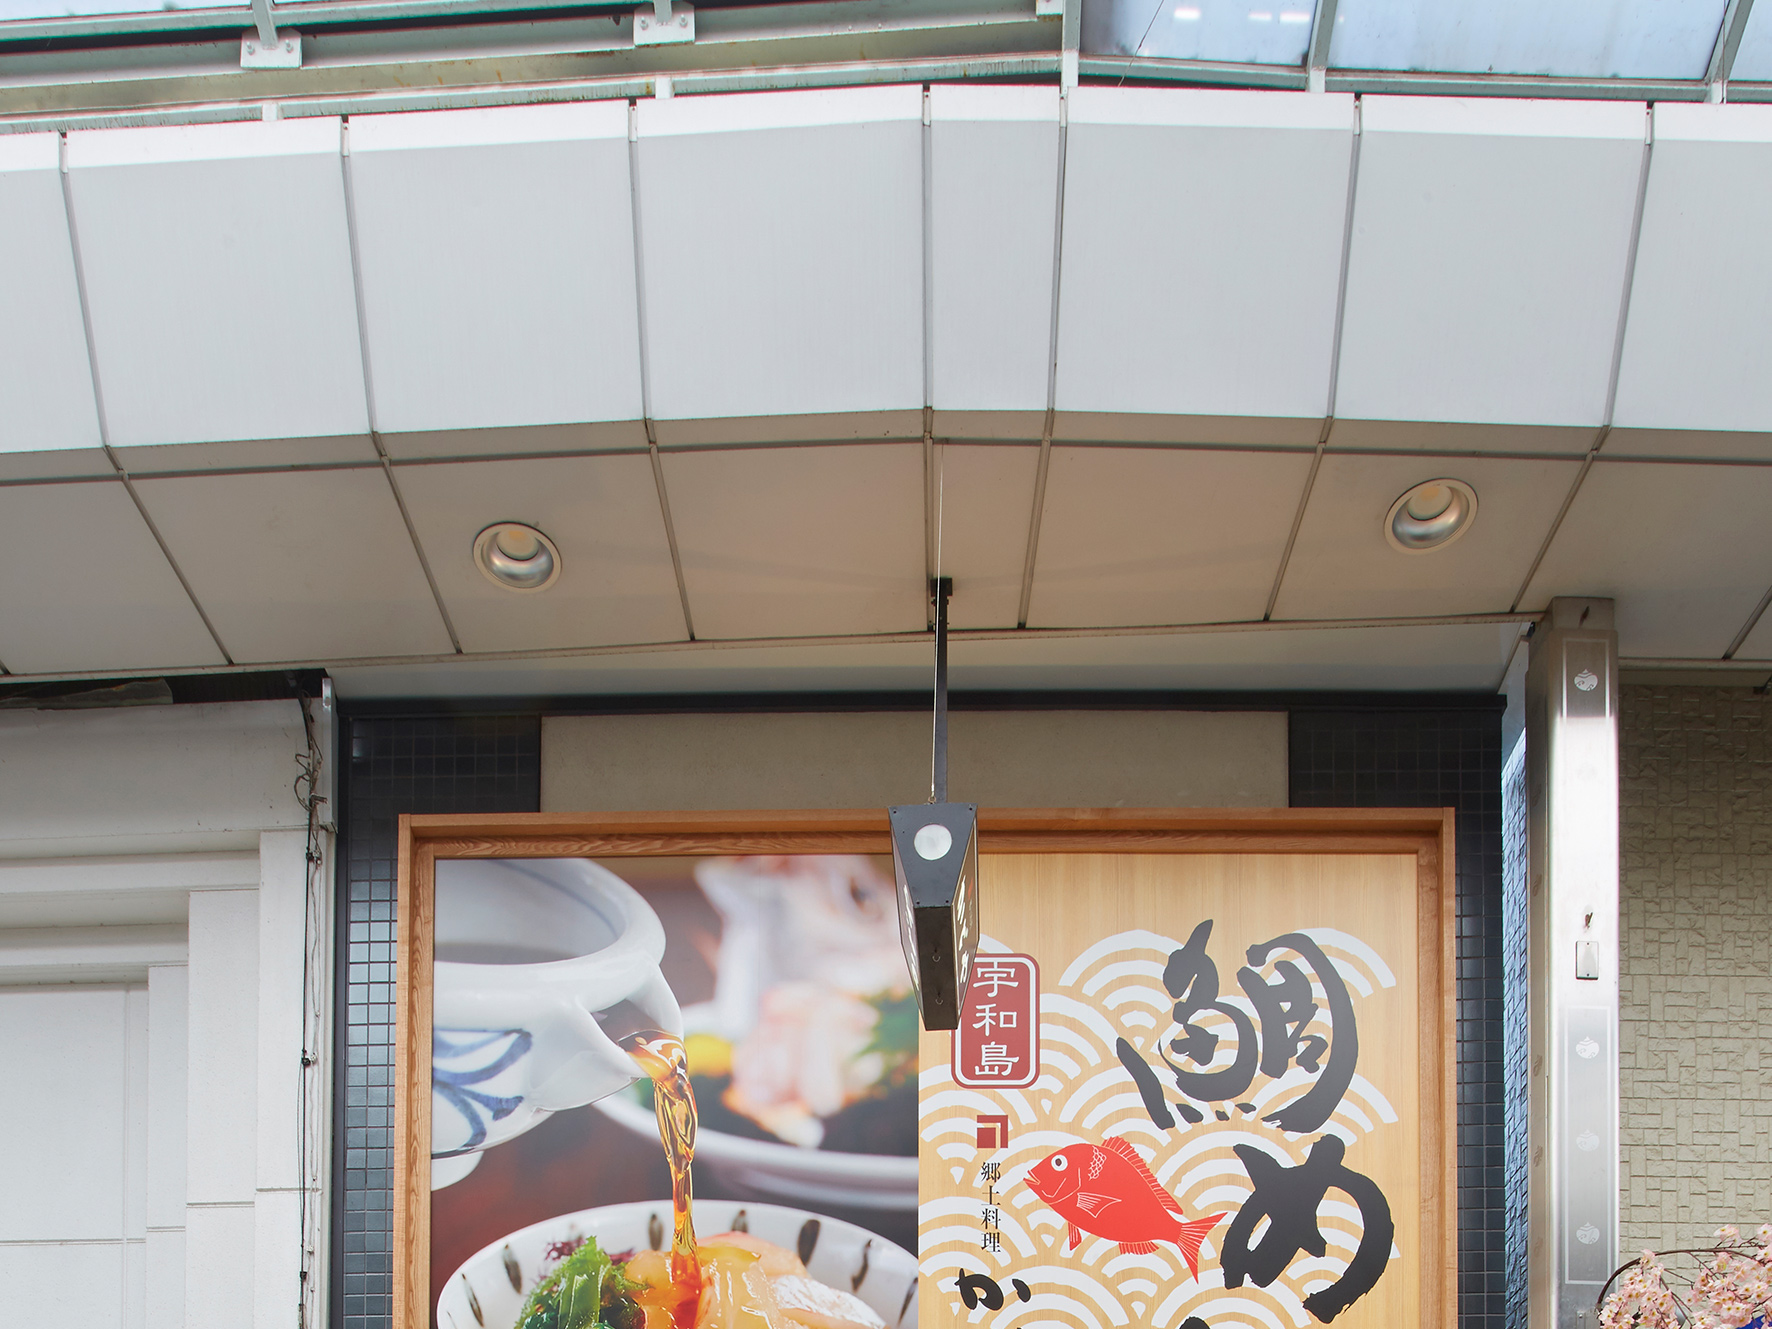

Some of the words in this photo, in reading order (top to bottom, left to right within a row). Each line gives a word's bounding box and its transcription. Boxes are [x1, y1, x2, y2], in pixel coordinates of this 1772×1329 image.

[972, 962, 1021, 1078] 宇和島
[980, 1161, 1002, 1254] 郷土料理
